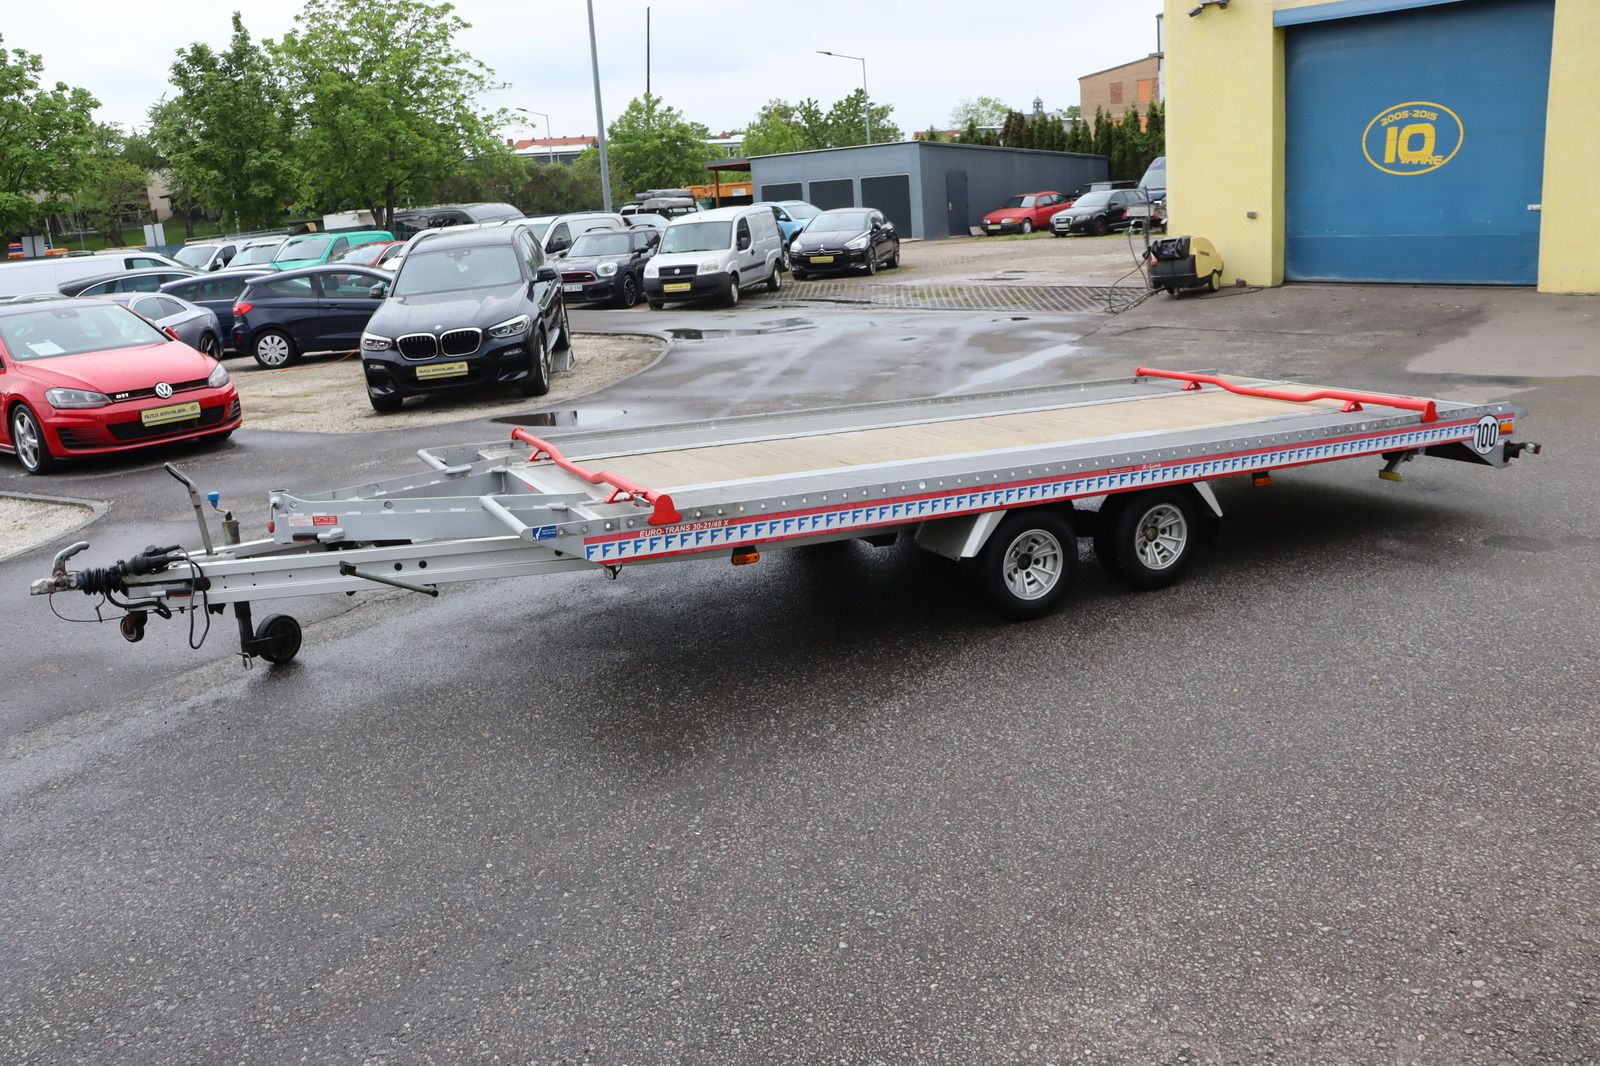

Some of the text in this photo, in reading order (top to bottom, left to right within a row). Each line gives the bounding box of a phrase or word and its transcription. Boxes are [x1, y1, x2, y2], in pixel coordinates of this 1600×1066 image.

[1380, 109, 1439, 127] 2005-2015
[1384, 122, 1436, 163] 10
[1476, 422, 1497, 449] 100
[639, 524, 691, 538] EURO-TRANS
